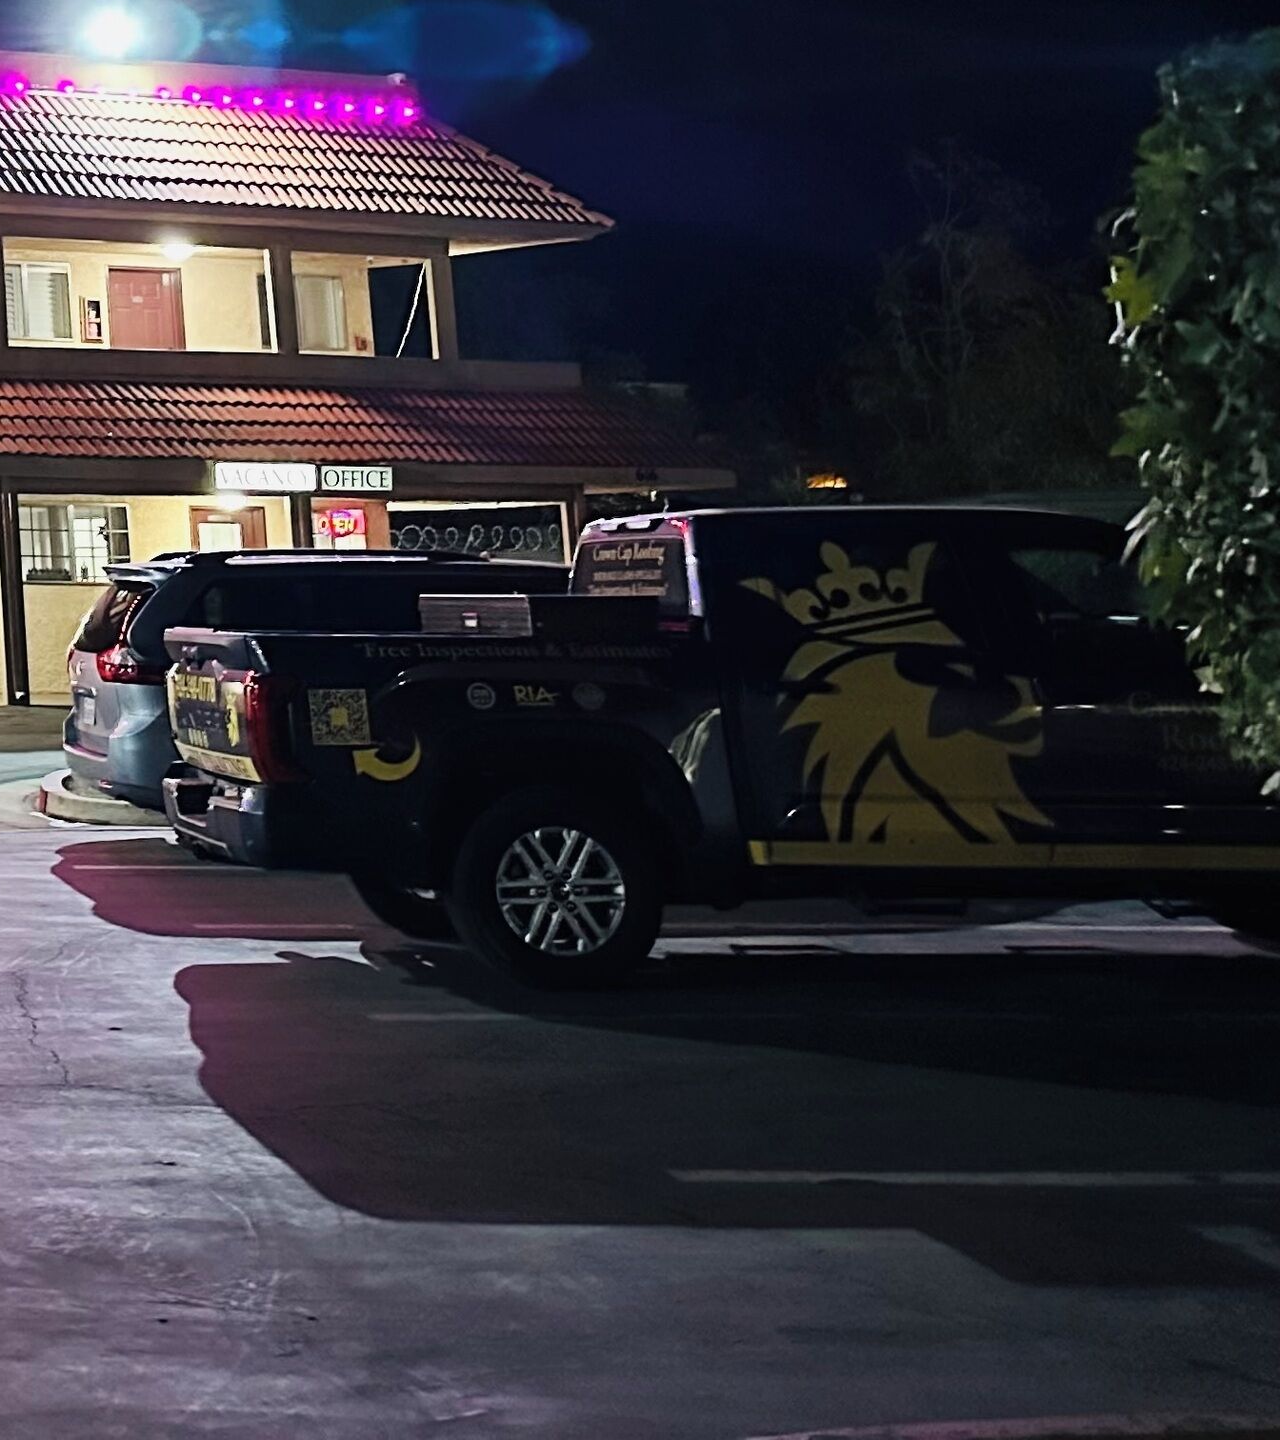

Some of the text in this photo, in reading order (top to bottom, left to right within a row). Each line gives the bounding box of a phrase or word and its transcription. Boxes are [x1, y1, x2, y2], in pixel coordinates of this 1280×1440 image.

[219, 467, 308, 487] VACANCY
[323, 468, 390, 489] OFFICE
[416, 642, 541, 662] Inspections
[512, 684, 560, 704] RIA
